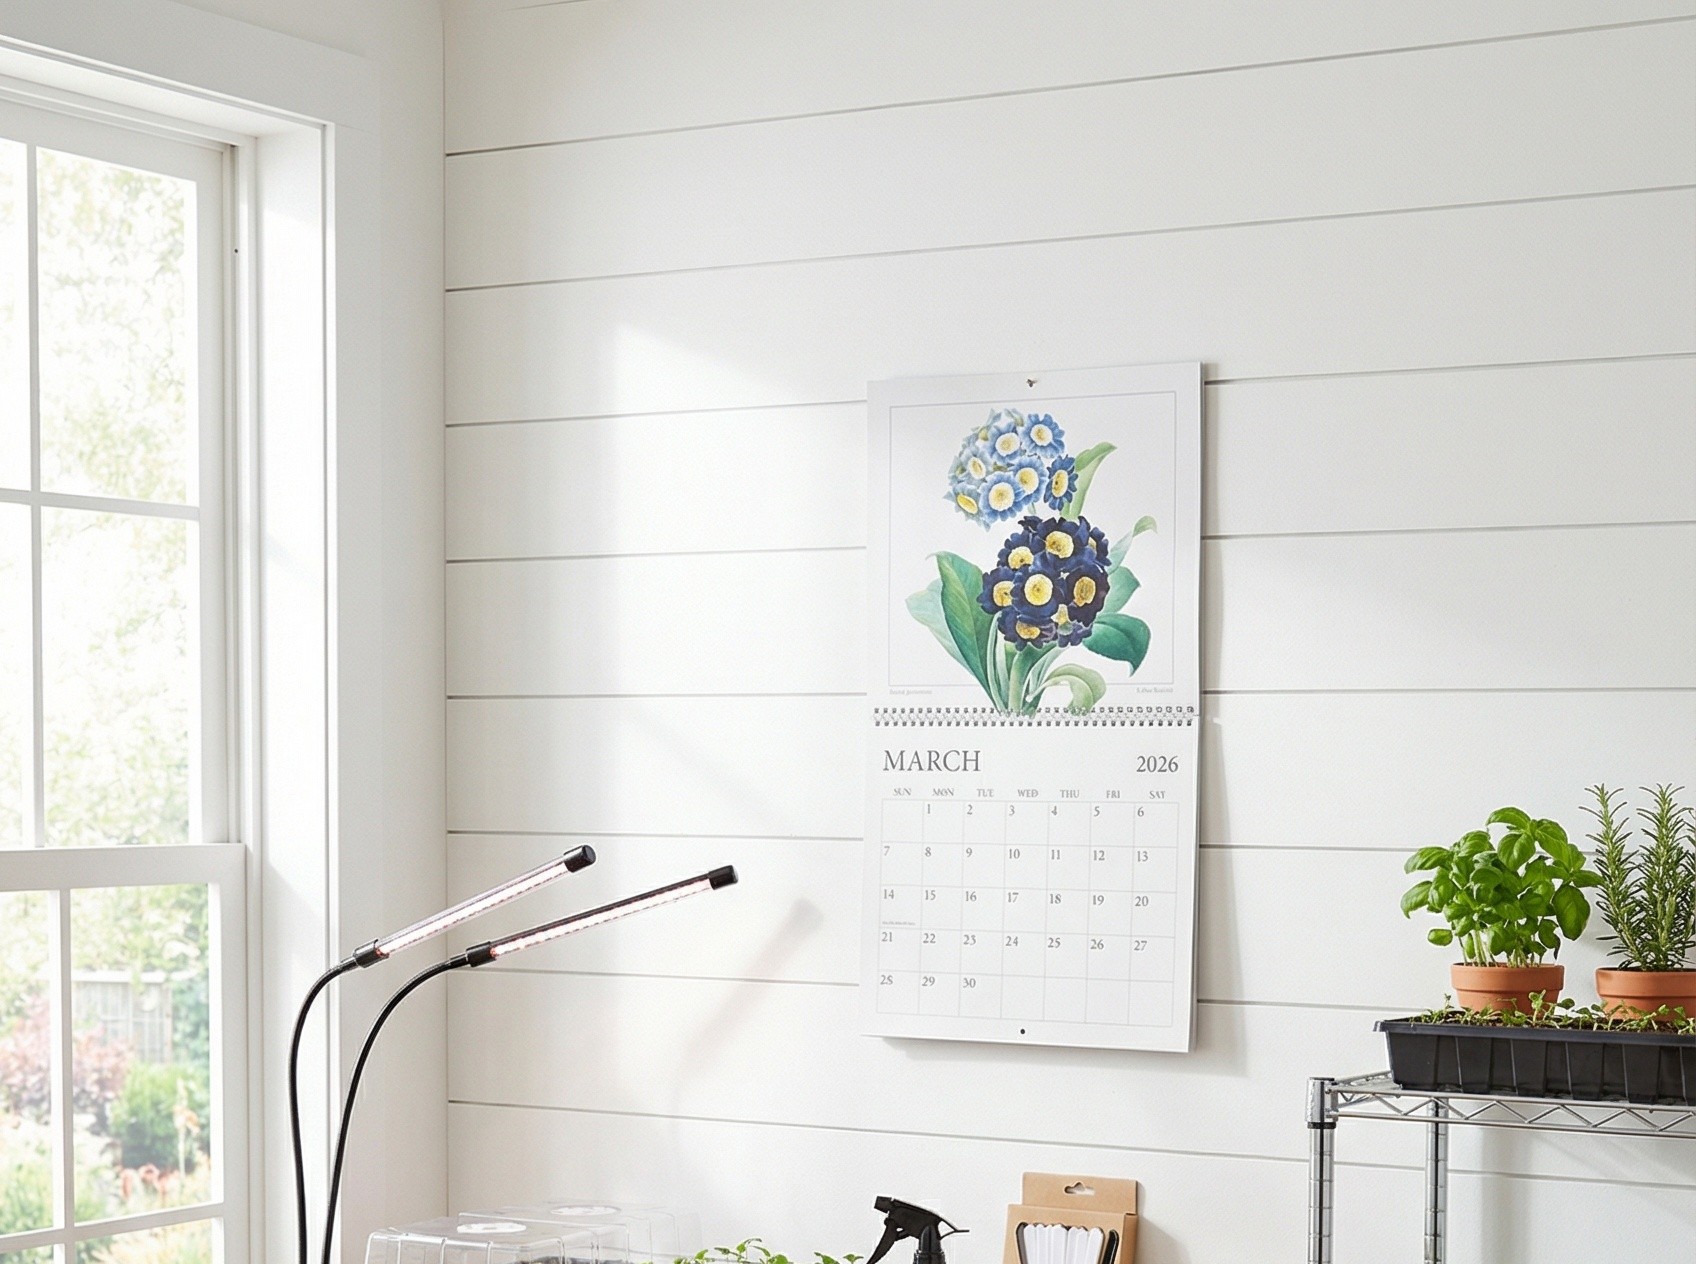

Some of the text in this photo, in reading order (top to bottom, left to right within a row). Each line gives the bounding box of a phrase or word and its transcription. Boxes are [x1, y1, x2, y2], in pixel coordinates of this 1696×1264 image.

[882, 749, 1179, 773] MARCH 2026
[893, 787, 1166, 800] SUN MON TUE WED THU FRI SAT
[926, 803, 1145, 818] 1 2 3 4 5 6
[883, 845, 1149, 863] 7 8 9 10 11 12 13
[883, 888, 1149, 907] 14 15 16 17 18 19 20
[881, 931, 1148, 952] 21 22 23 24 25 26 27
[921, 975, 936, 987] 29
[962, 977, 977, 989] 30
